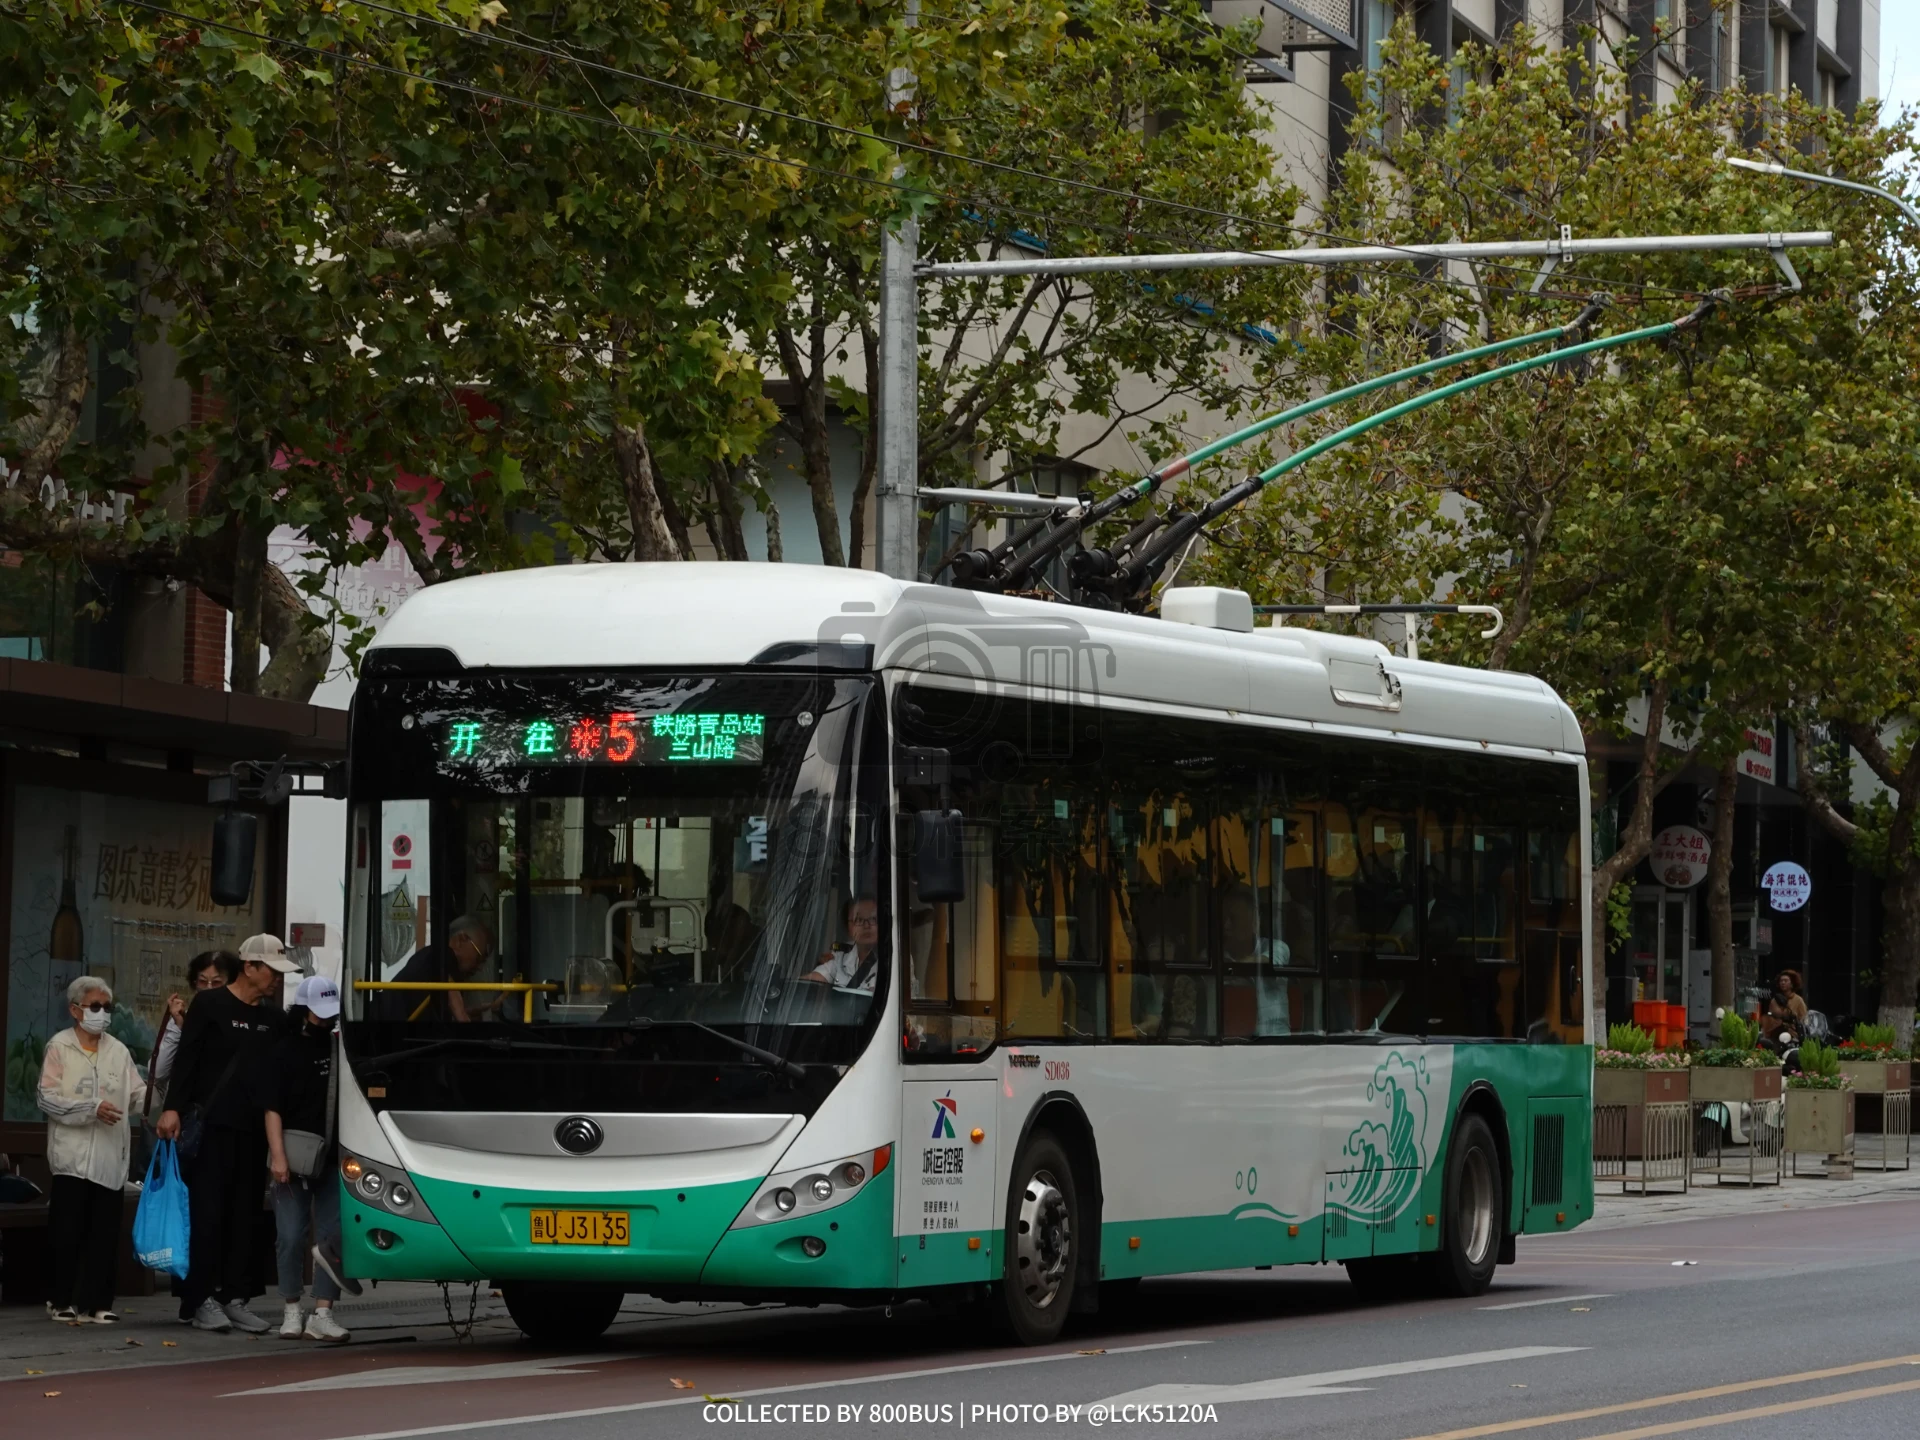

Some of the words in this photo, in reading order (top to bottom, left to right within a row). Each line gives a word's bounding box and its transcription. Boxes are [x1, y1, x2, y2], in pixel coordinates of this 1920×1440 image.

[607, 713, 637, 761] 5
[653, 714, 765, 737] 铁路青岛站
[668, 737, 736, 760] 兰山路
[1659, 832, 1704, 850] 王大姐
[93, 843, 253, 917] 图乐意霞多丽
[1045, 1061, 1070, 1081] SD036
[922, 1147, 964, 1175] 城运控股
[922, 1177, 944, 1186] CHENGYUN
[945, 1177, 963, 1186] HOLDING
